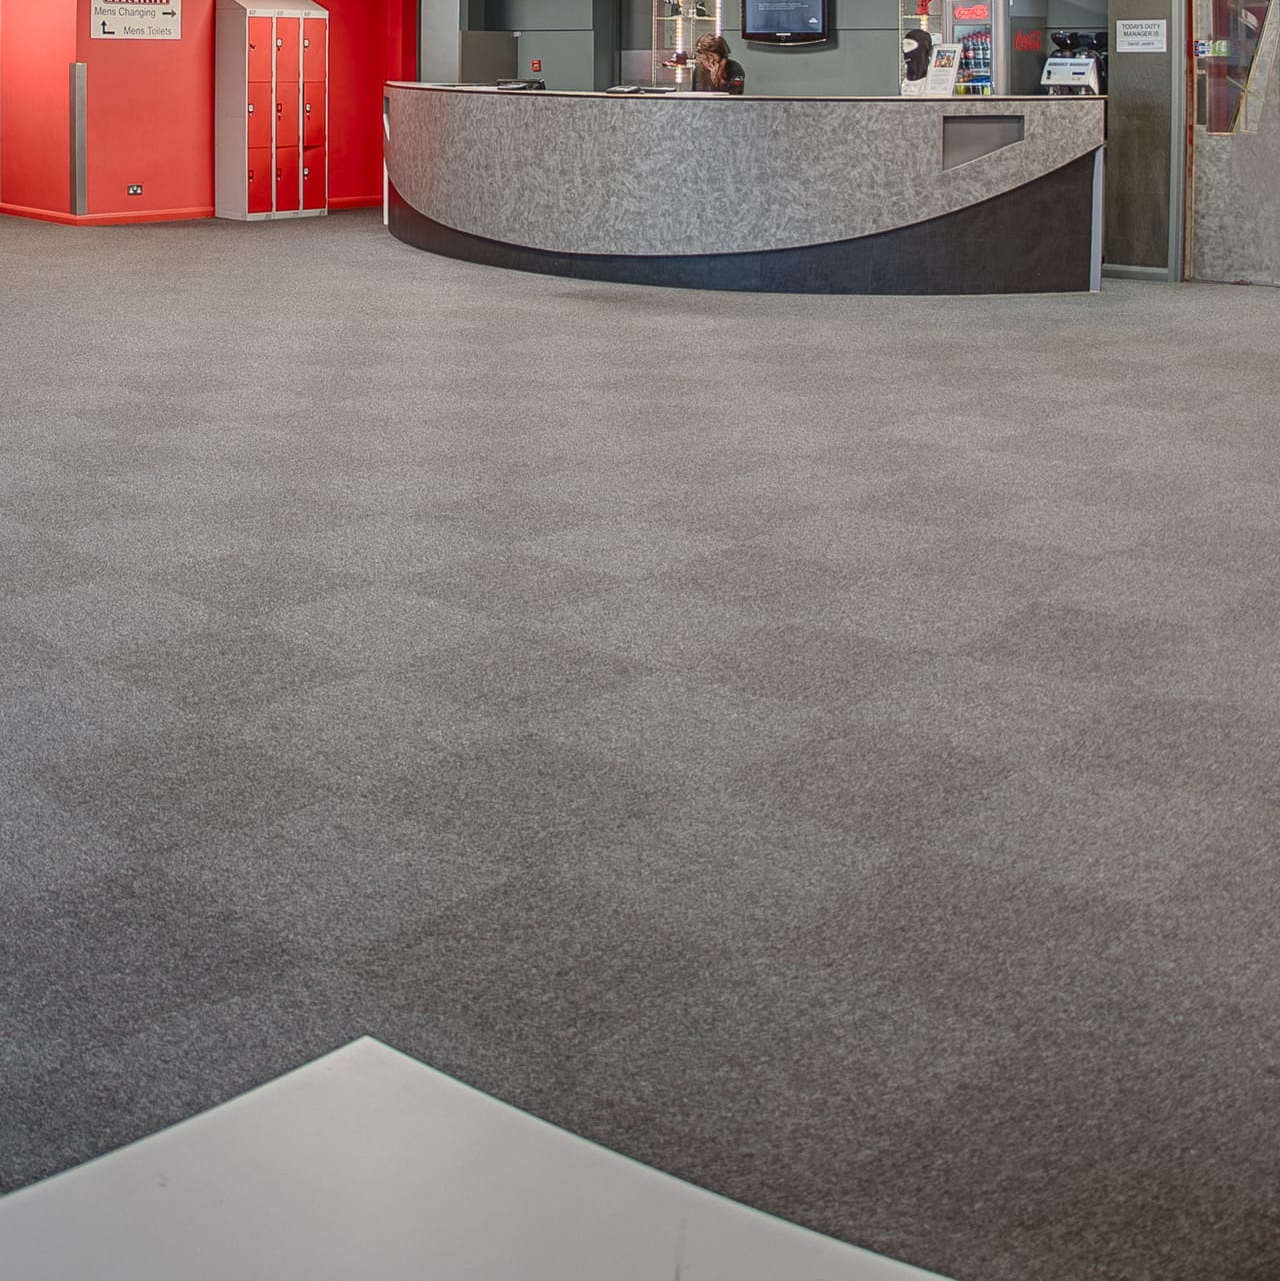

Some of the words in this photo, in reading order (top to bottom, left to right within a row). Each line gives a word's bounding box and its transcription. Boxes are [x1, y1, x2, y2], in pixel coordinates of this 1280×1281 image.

[94, 6, 116, 16] Mens
[118, 7, 156, 19] Changing
[123, 26, 145, 35] Mens
[147, 26, 172, 35] Toilets
